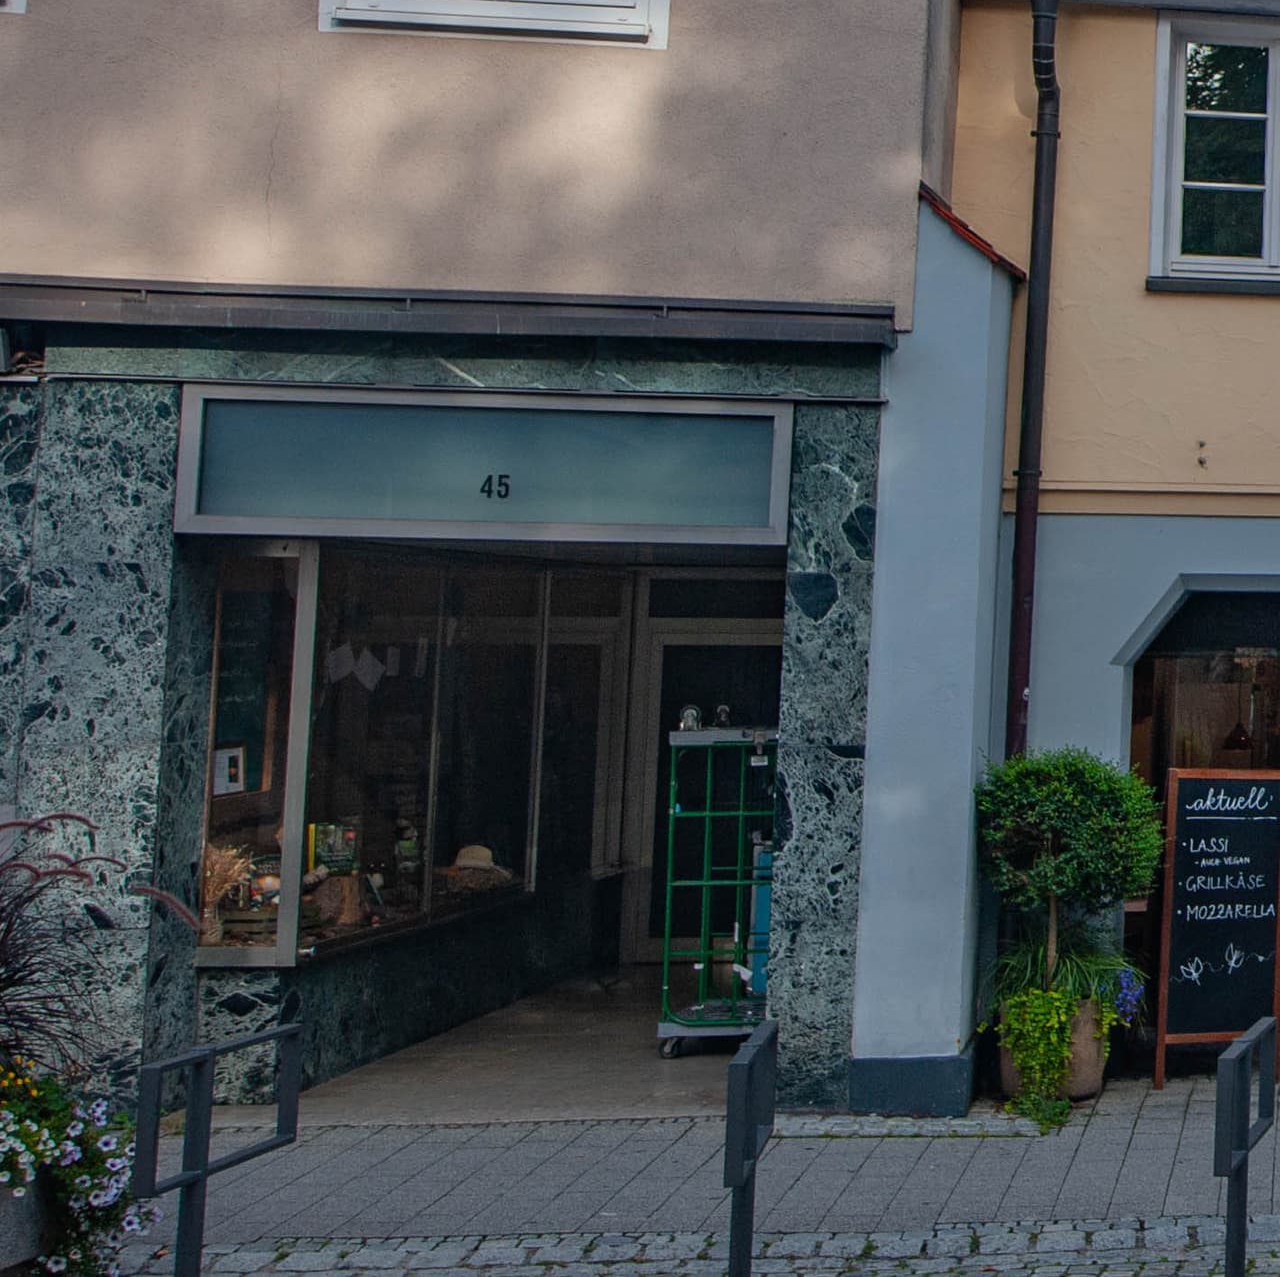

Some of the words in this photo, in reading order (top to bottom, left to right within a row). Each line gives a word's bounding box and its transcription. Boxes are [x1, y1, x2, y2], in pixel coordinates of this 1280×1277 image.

[480, 474, 510, 499] 45
[1186, 786, 1269, 811] aktuell
[1190, 837, 1229, 853] LASSI
[1223, 856, 1251, 866] VEGAN
[1186, 872, 1267, 893] GRILLKÄSE
[1186, 903, 1277, 922] MOZZARELLA
